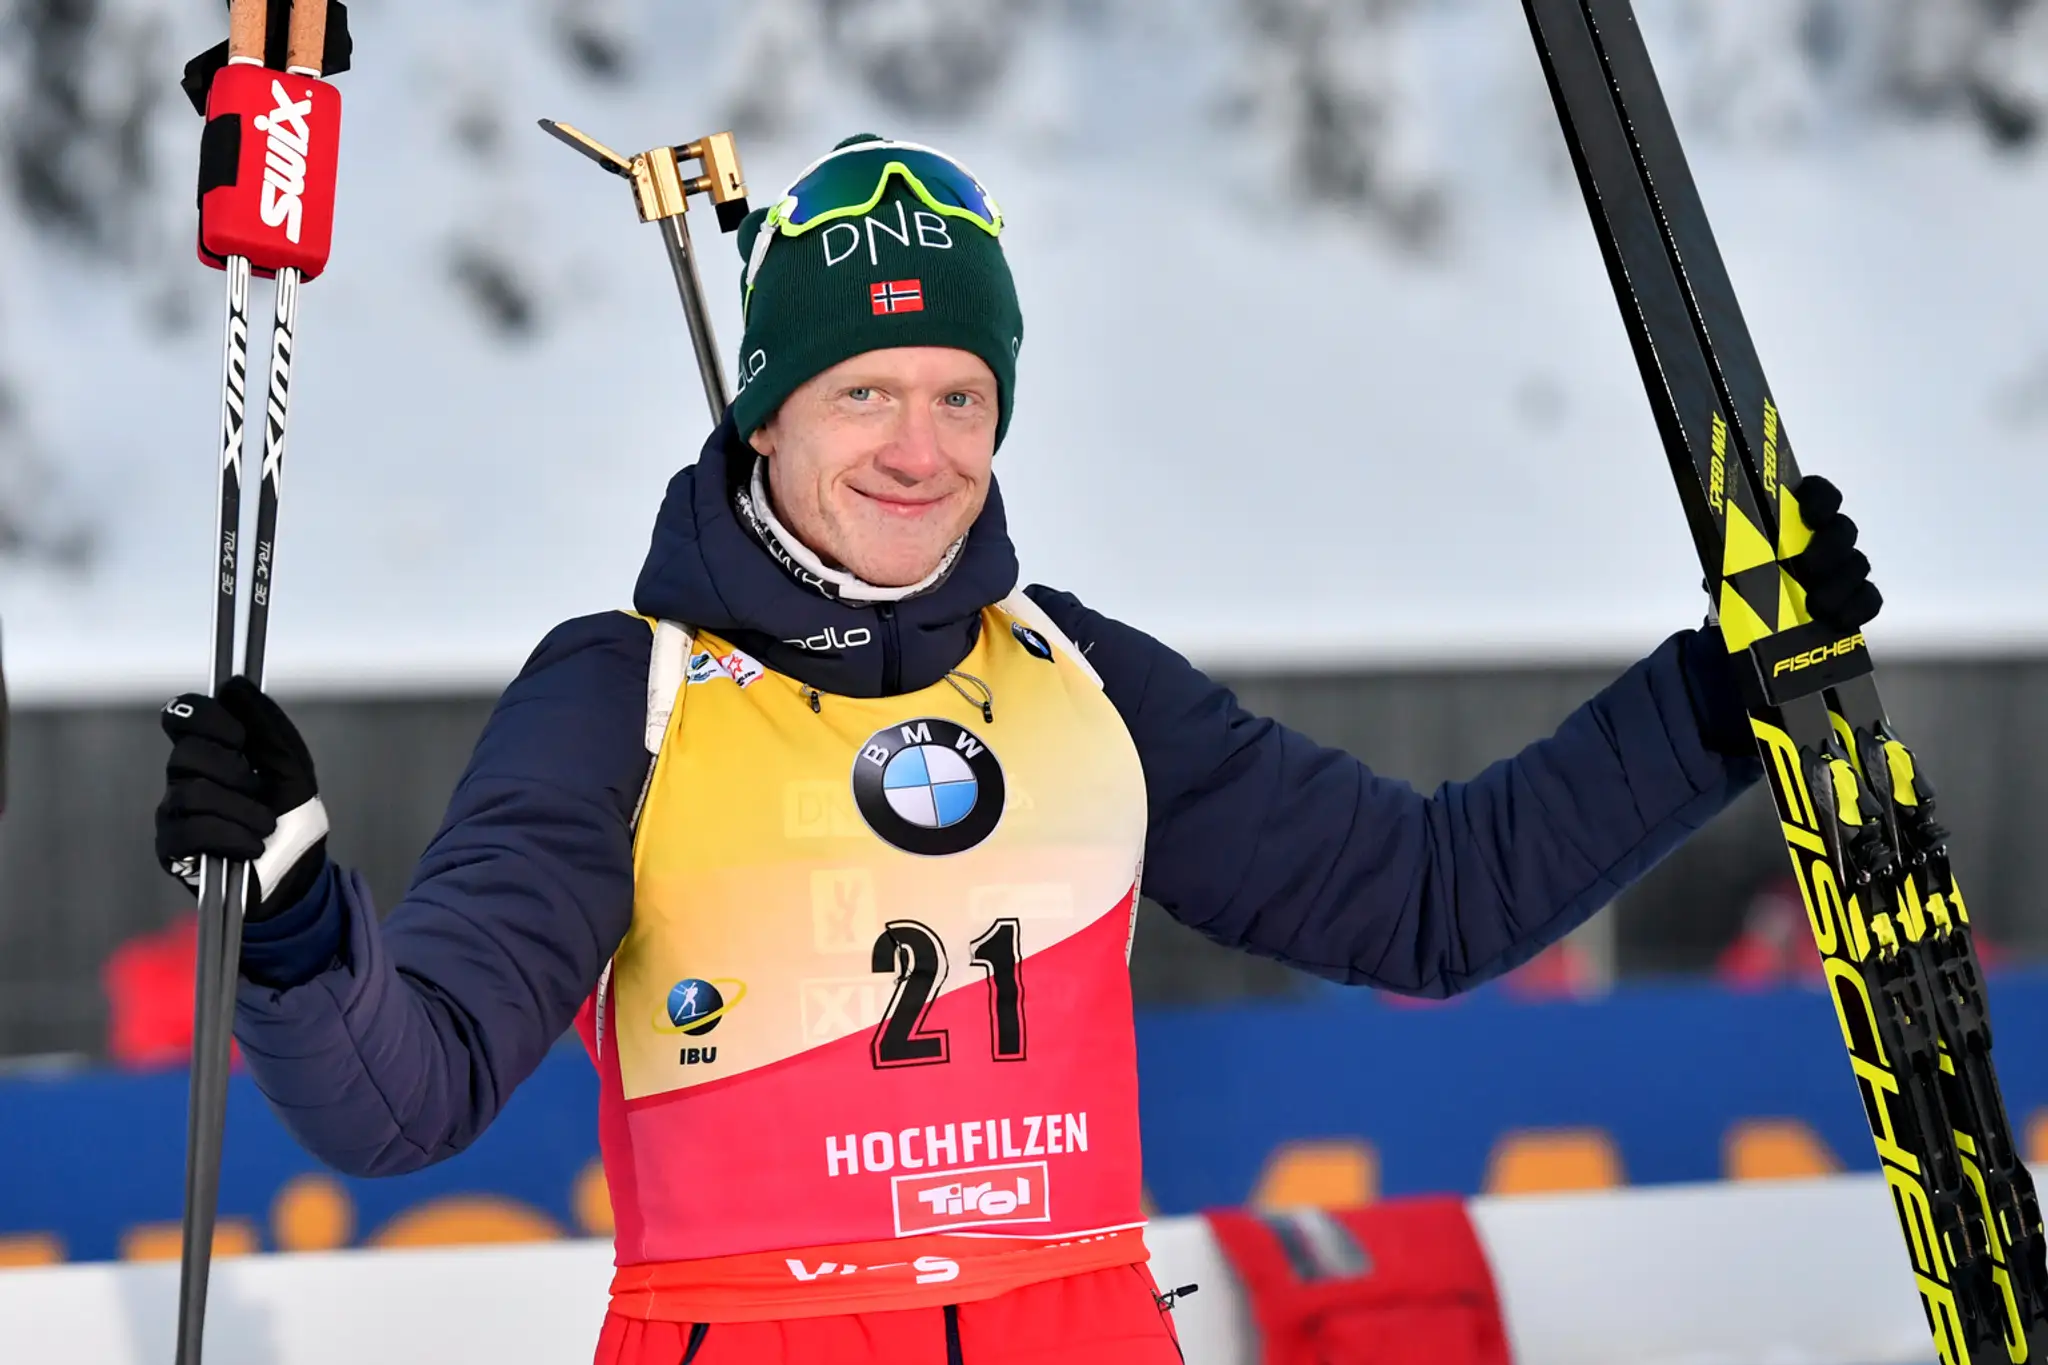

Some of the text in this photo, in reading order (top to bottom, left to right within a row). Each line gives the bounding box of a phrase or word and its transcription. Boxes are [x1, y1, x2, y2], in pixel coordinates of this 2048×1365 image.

[821, 200, 953, 267] DNB
[1773, 633, 1866, 678] FISCHER
[864, 721, 984, 768] BMW
[870, 917, 1028, 1070] 21
[679, 1046, 718, 1066] IBU
[825, 1111, 1089, 1177] HOCHFILZEN
[918, 1177, 1031, 1216] Tirol
